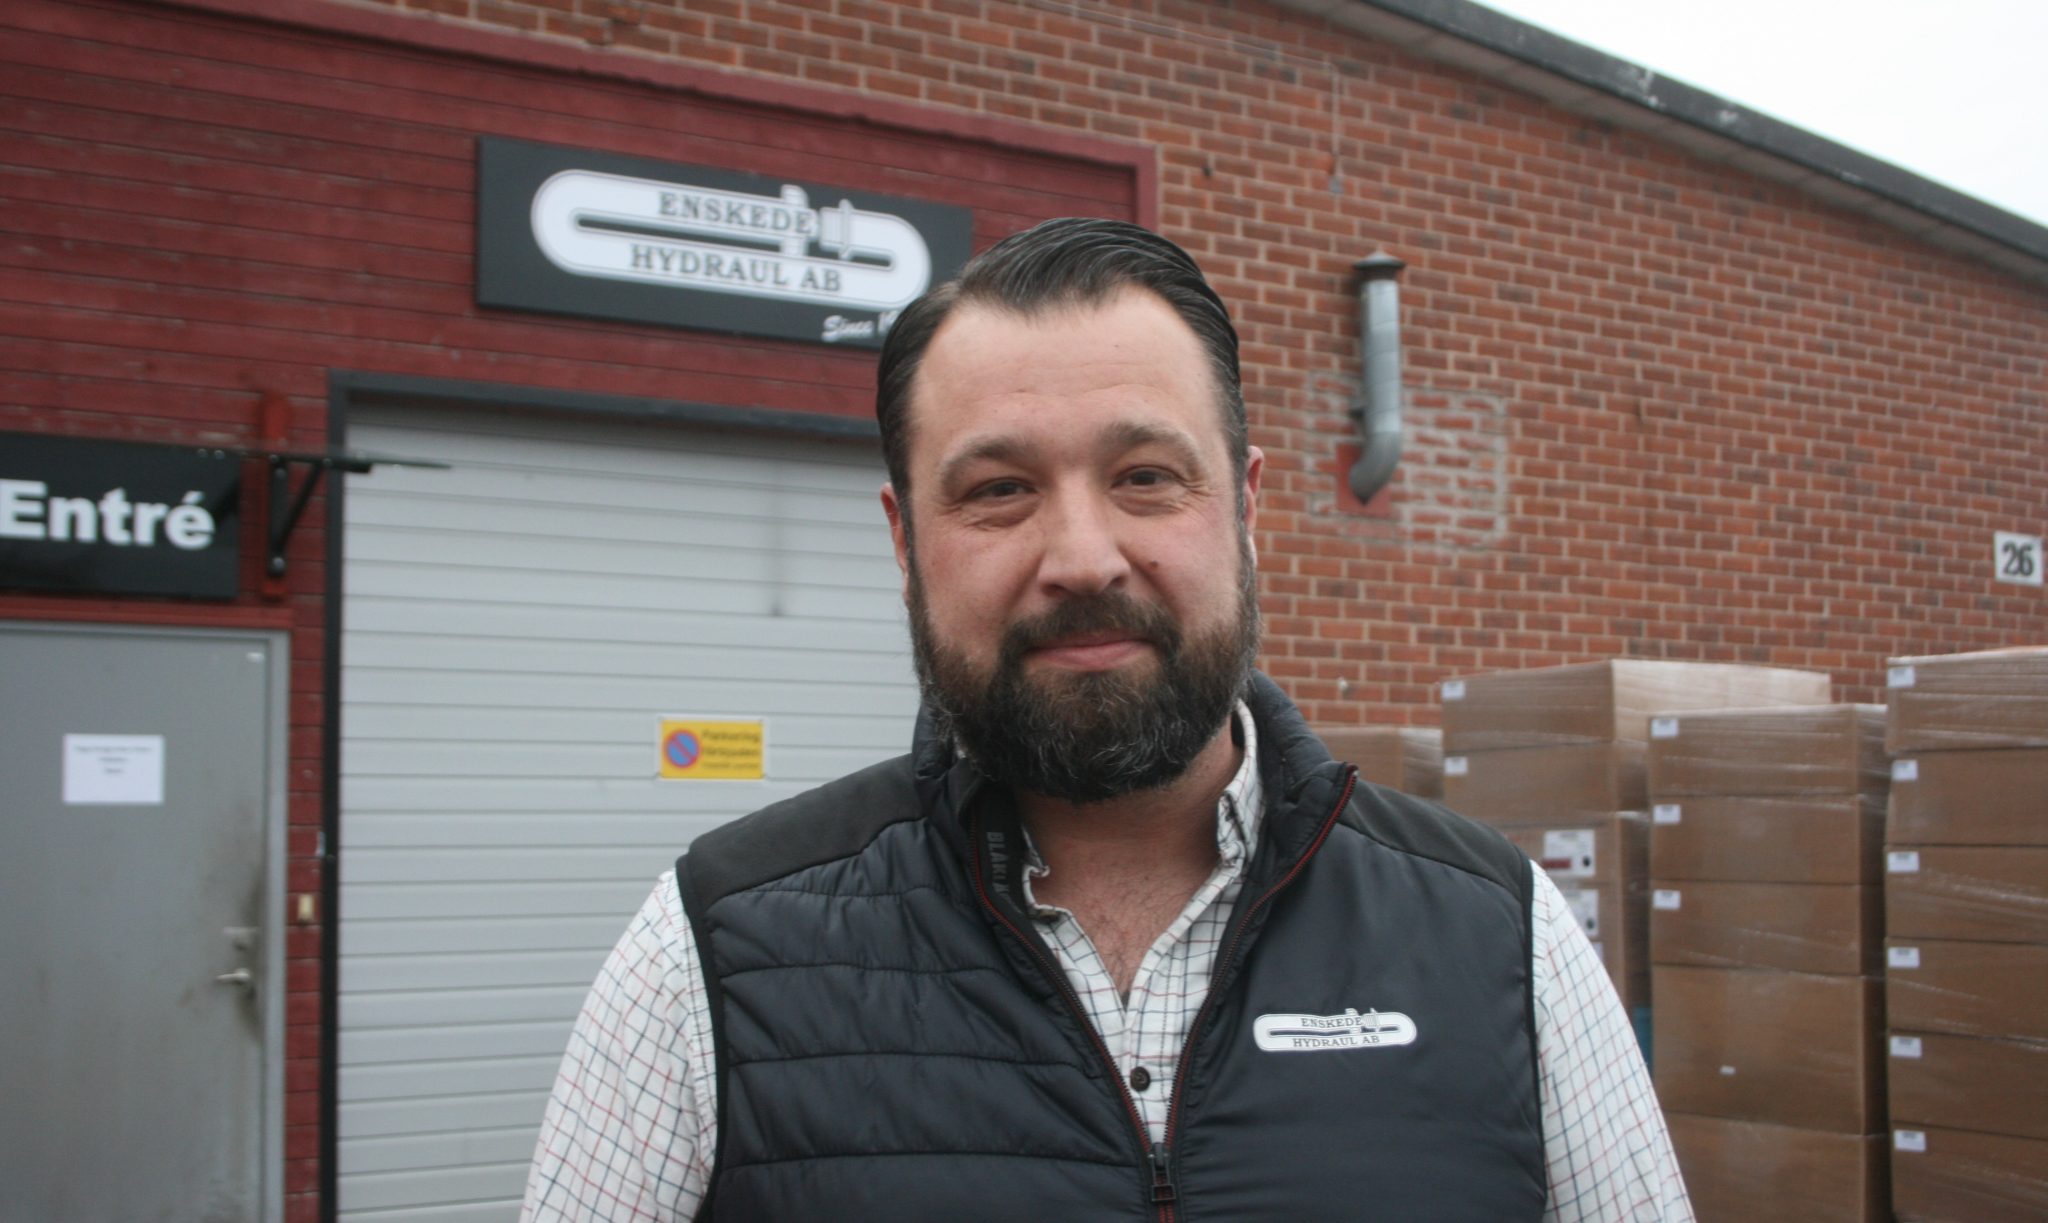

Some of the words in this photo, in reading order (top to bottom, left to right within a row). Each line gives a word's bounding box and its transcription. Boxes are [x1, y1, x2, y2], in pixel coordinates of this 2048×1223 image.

[659, 190, 813, 235] ENSKEDE
[630, 244, 788, 286] HYDRAUL
[800, 265, 842, 293] AB
[821, 314, 874, 342] Since
[0, 477, 215, 550] Entré
[2002, 541, 2035, 577] 26
[1301, 1015, 1363, 1029] ENSKEDE
[1292, 1036, 1358, 1048] HYDRAUL
[1362, 1035, 1381, 1045] AB
